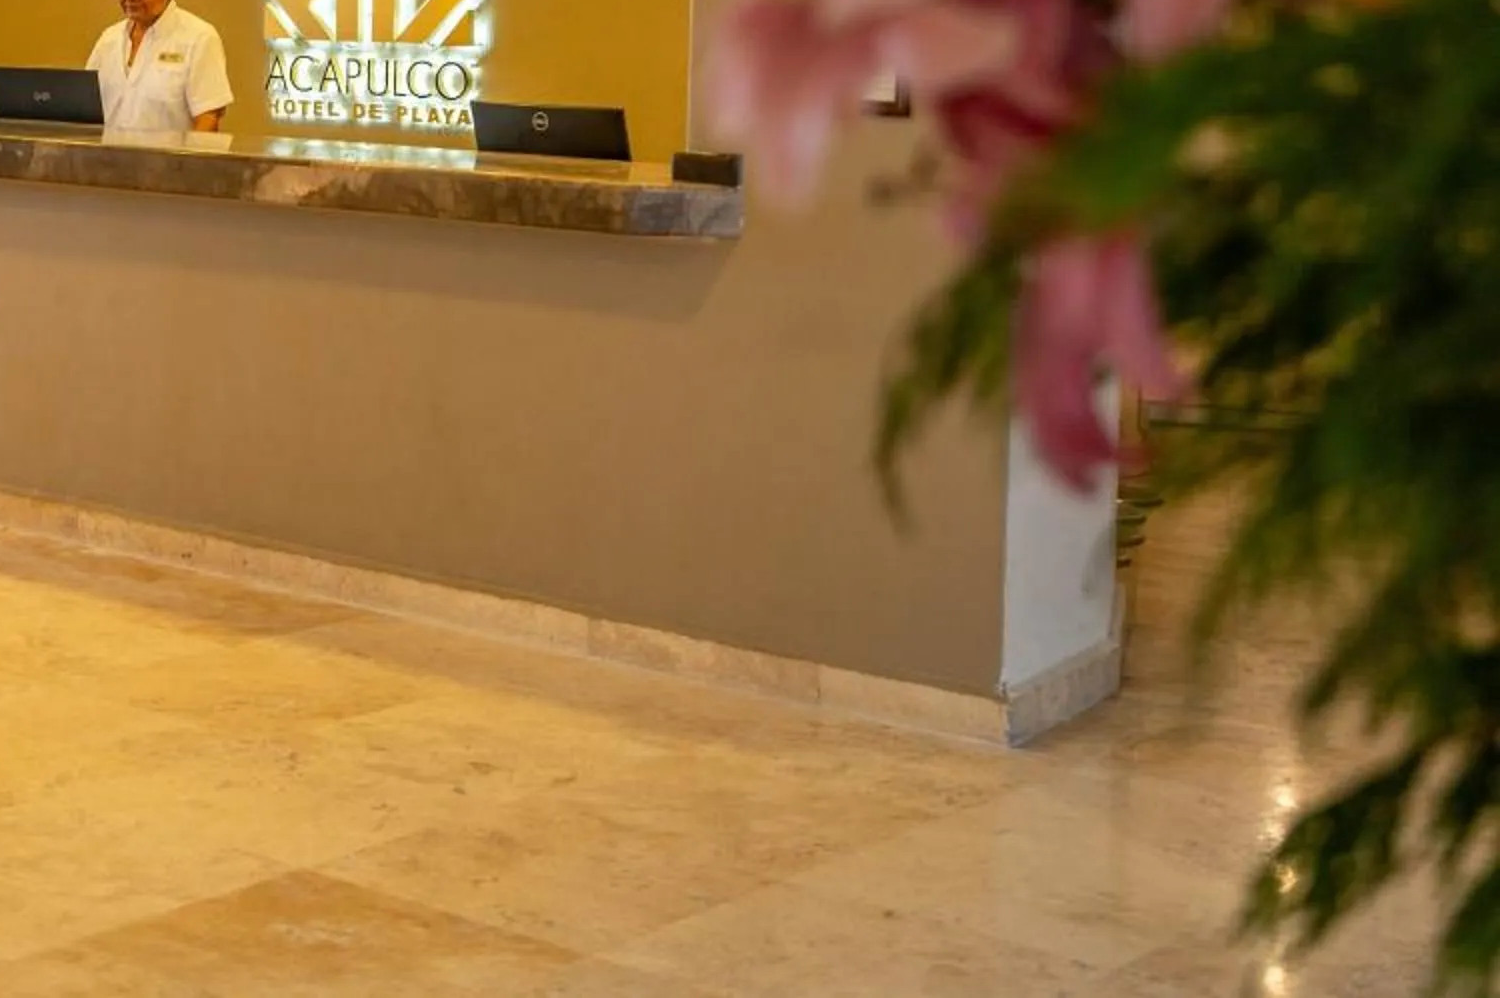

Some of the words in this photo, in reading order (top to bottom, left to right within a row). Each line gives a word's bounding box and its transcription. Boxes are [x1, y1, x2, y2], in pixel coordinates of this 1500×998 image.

[265, 55, 470, 102] ACAPULCO
[270, 99, 340, 119] HOTEL
[352, 102, 382, 119] DE
[395, 105, 473, 125] PLAYA
